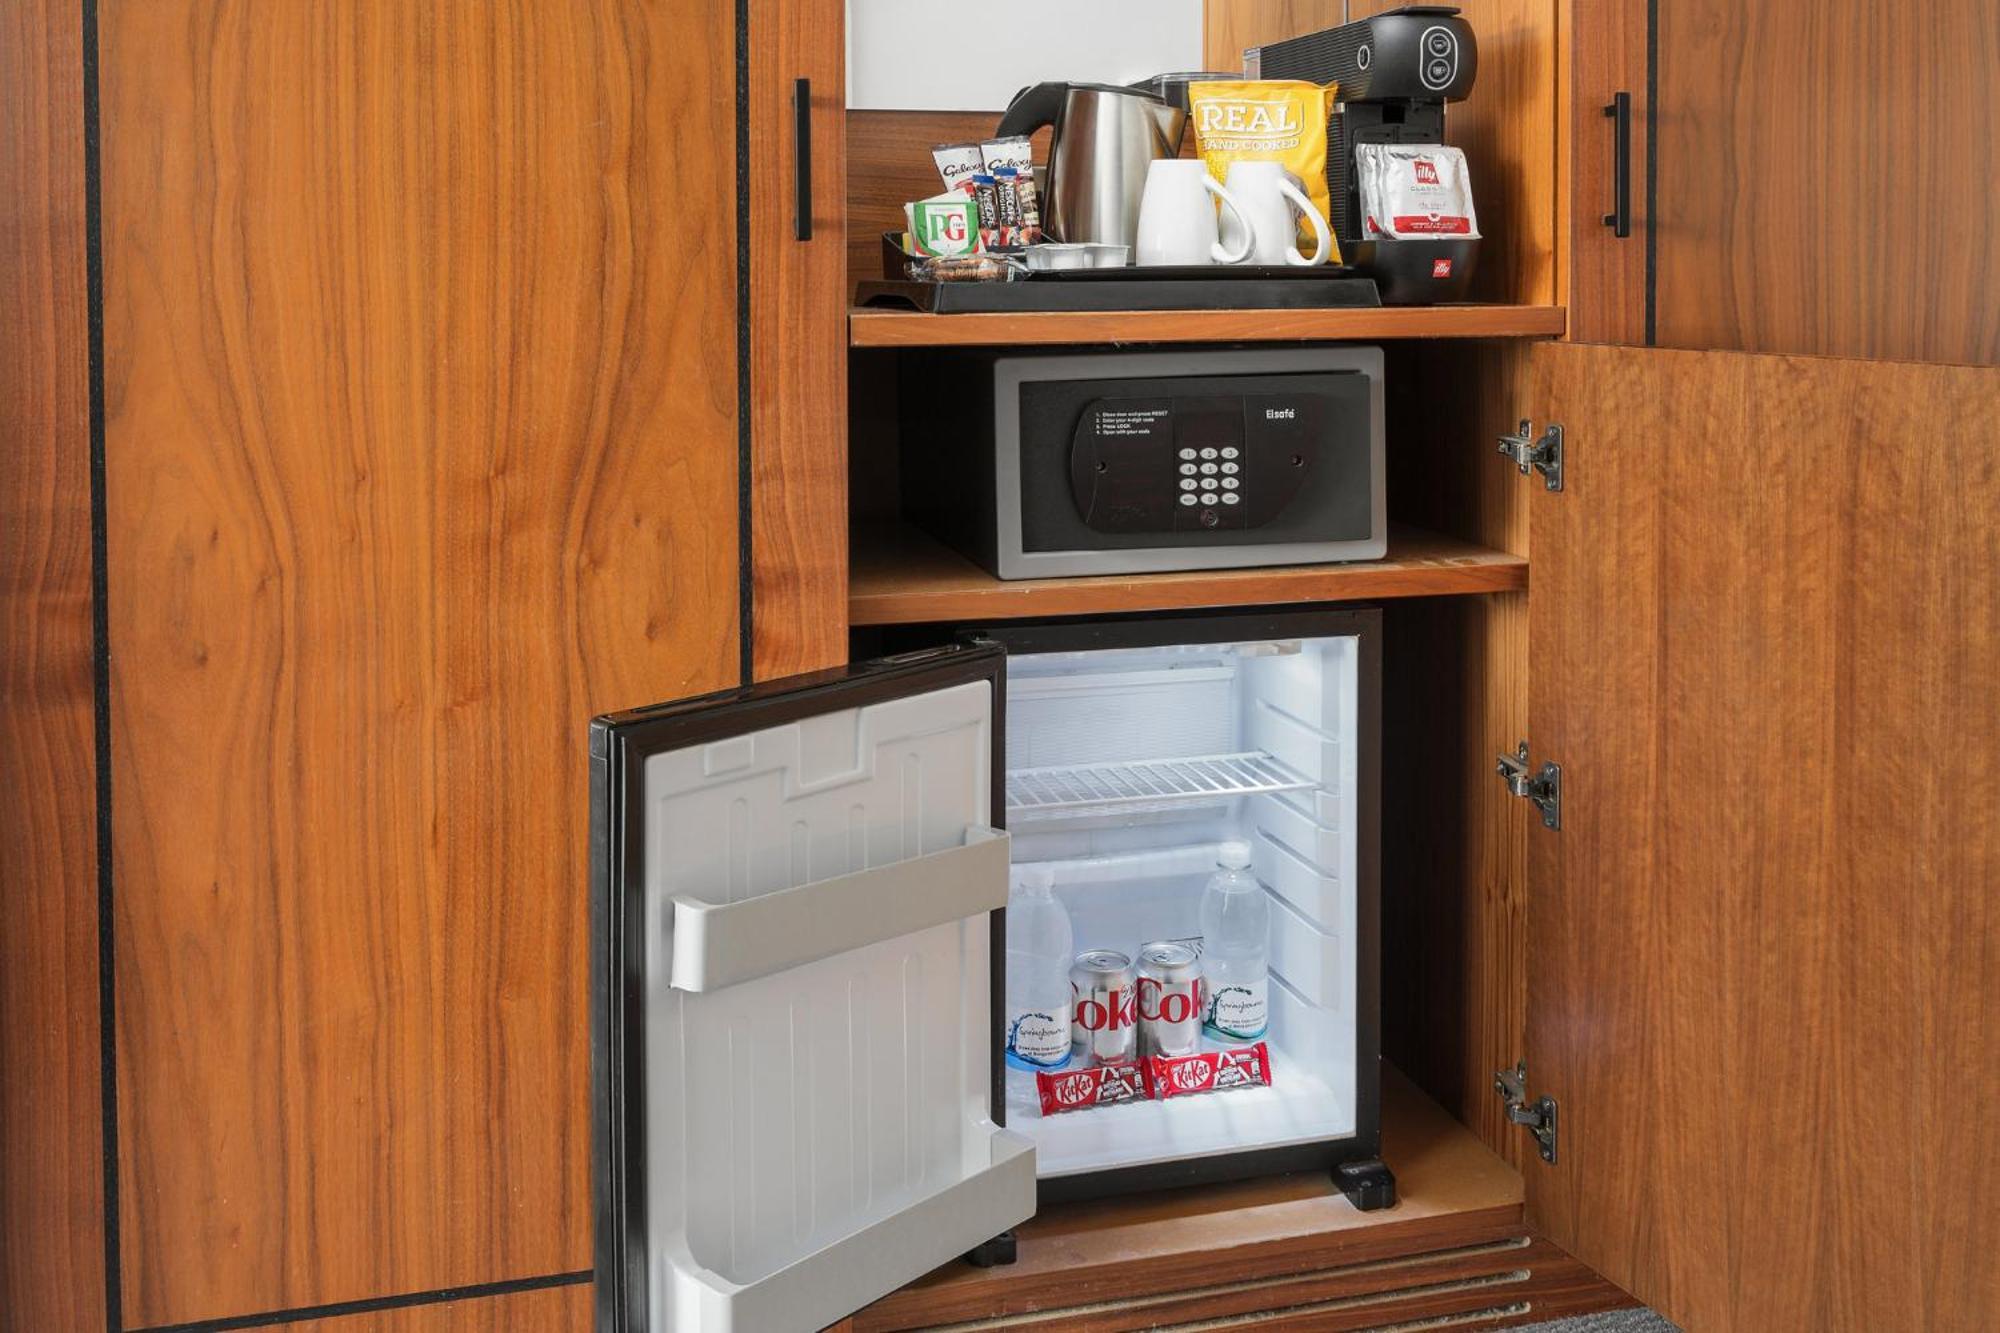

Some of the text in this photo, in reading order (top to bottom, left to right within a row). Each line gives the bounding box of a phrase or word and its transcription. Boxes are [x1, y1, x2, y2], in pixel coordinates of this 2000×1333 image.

[1200, 104, 1297, 132] REAL
[943, 162, 985, 177] Galaxy
[1418, 165, 1435, 179] illy
[929, 213, 965, 241] PG
[1071, 981, 1137, 1031] ok
[1176, 1060, 1209, 1089] KitKat
[1057, 1075, 1093, 1104] KitKat
